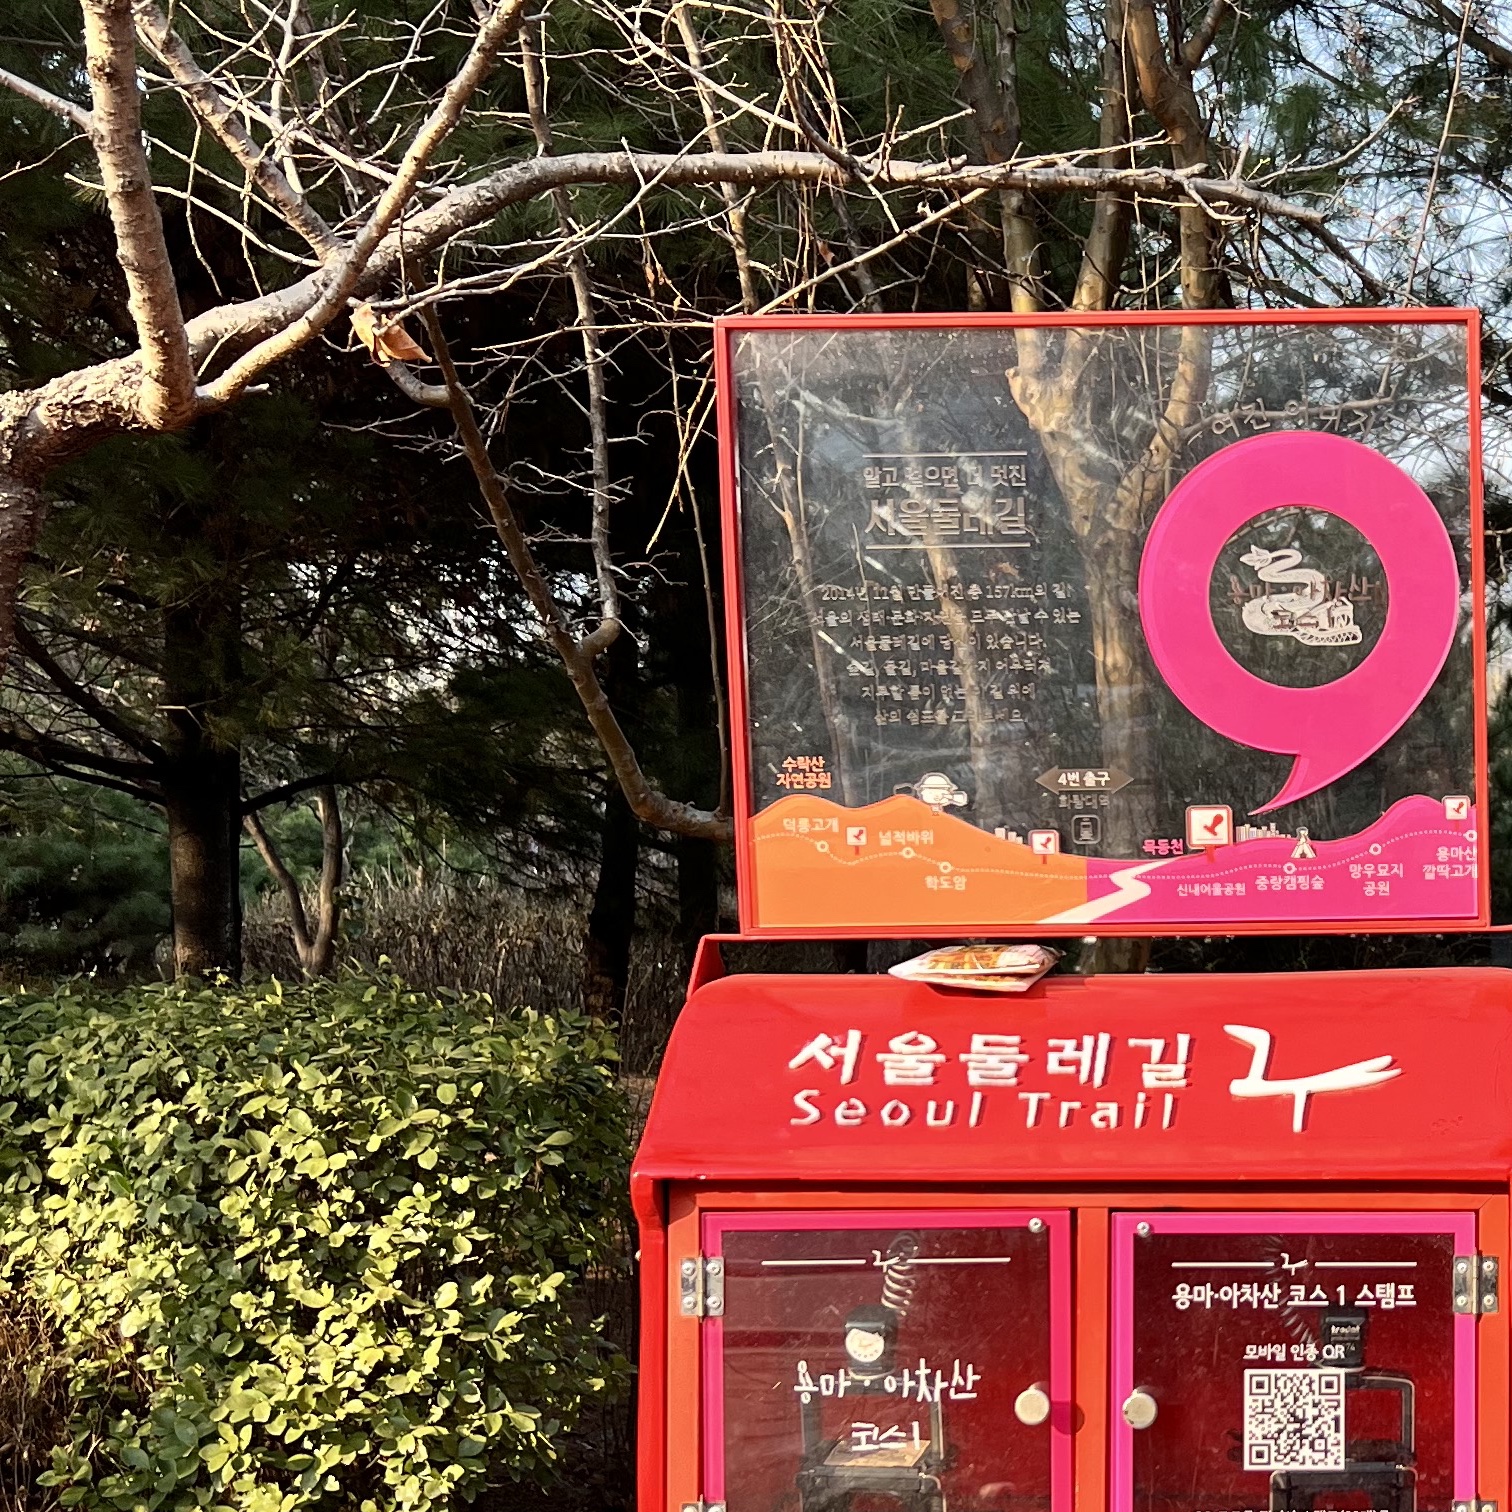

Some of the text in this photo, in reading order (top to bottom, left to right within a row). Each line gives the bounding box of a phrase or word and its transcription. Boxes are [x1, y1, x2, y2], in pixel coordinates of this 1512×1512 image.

[863, 465, 899, 489] 알고
[990, 464, 1027, 487] 멋진
[864, 497, 1027, 535] 서울둘레길
[1034, 608, 1050, 624] 수
[1052, 607, 1081, 625] 있는
[849, 633, 936, 651] 서울둘레길에
[782, 755, 826, 773] 수락산
[776, 772, 832, 789] 자연공원
[1057, 771, 1111, 787] 4번 출구
[1142, 838, 1184, 855] 묵동천
[1435, 845, 1478, 862] 용마산
[1348, 862, 1404, 878] 망우묘지
[1422, 863, 1478, 880] 깔딱고개
[924, 875, 968, 891] 학도암
[1176, 882, 1246, 897] 신내어울공원
[1254, 875, 1325, 891] 중랑캠핑숲
[1363, 881, 1391, 897] 공원
[789, 1029, 1191, 1088] 서울둘레길
[790, 1089, 1176, 1129] Seoul Trail
[1172, 1282, 1417, 1310] 용마·아차산 코스 1 스탬프
[1243, 1343, 1287, 1361] 모바일
[1290, 1343, 1319, 1361] 인증
[1322, 1344, 1346, 1360] QR
